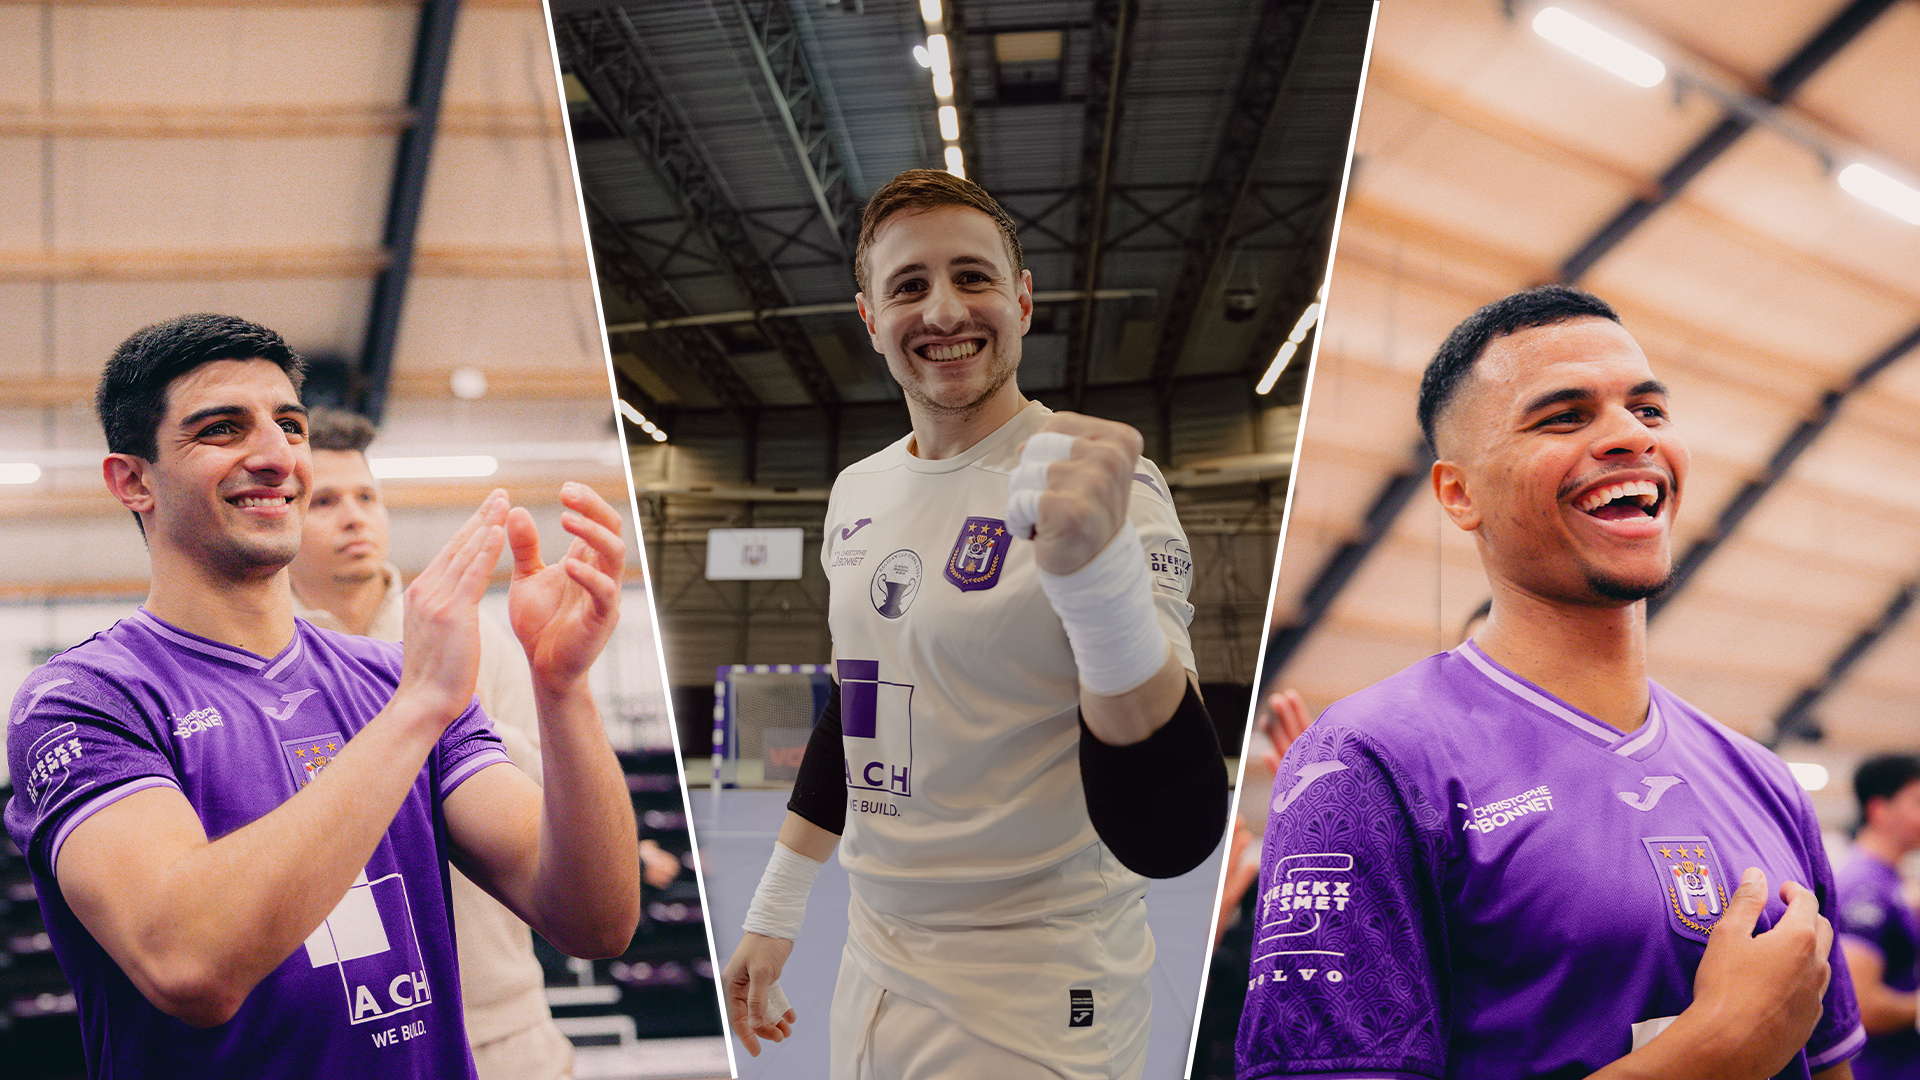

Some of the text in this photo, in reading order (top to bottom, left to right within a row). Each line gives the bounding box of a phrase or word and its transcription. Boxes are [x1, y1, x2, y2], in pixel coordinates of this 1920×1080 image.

[1151, 562, 1168, 573] DE
[40, 746, 82, 783] SMET
[860, 800, 901, 817] BUILD.
[1473, 785, 1551, 818] CHRISTOPHE
[1476, 796, 1554, 834] BONNET
[1263, 881, 1351, 909] STERCKX
[1279, 895, 1350, 912] SMET
[1248, 968, 1343, 991] VOLVO
[371, 1028, 399, 1048] WE
